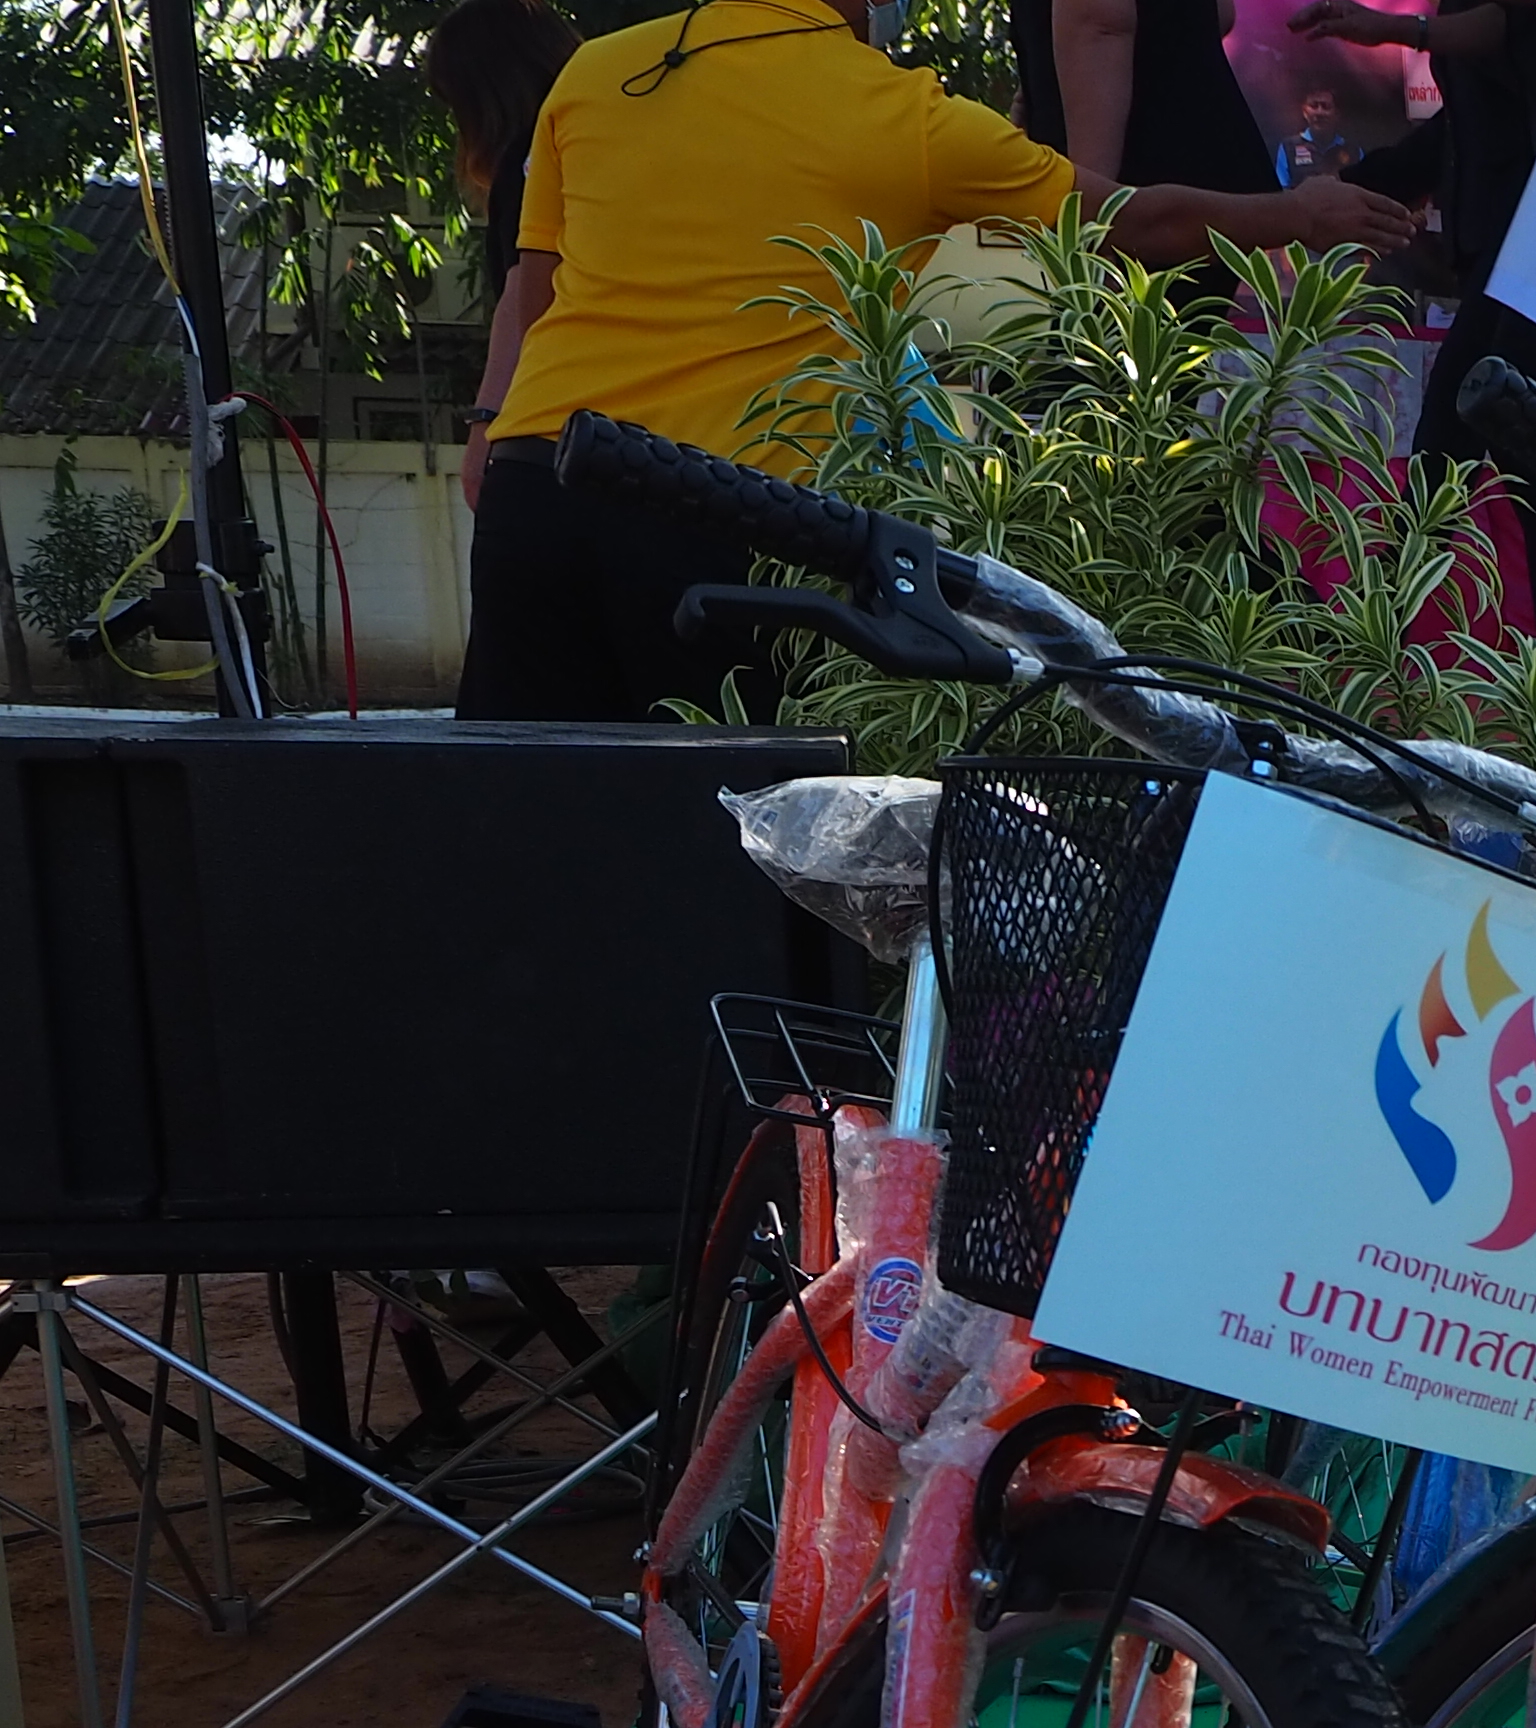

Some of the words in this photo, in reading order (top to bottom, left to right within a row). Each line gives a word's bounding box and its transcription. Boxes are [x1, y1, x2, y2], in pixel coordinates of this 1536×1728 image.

[1218, 1310, 1276, 1349] Thai
[1289, 1331, 1374, 1379] Women
[1382, 1360, 1520, 1418] Empowerment
